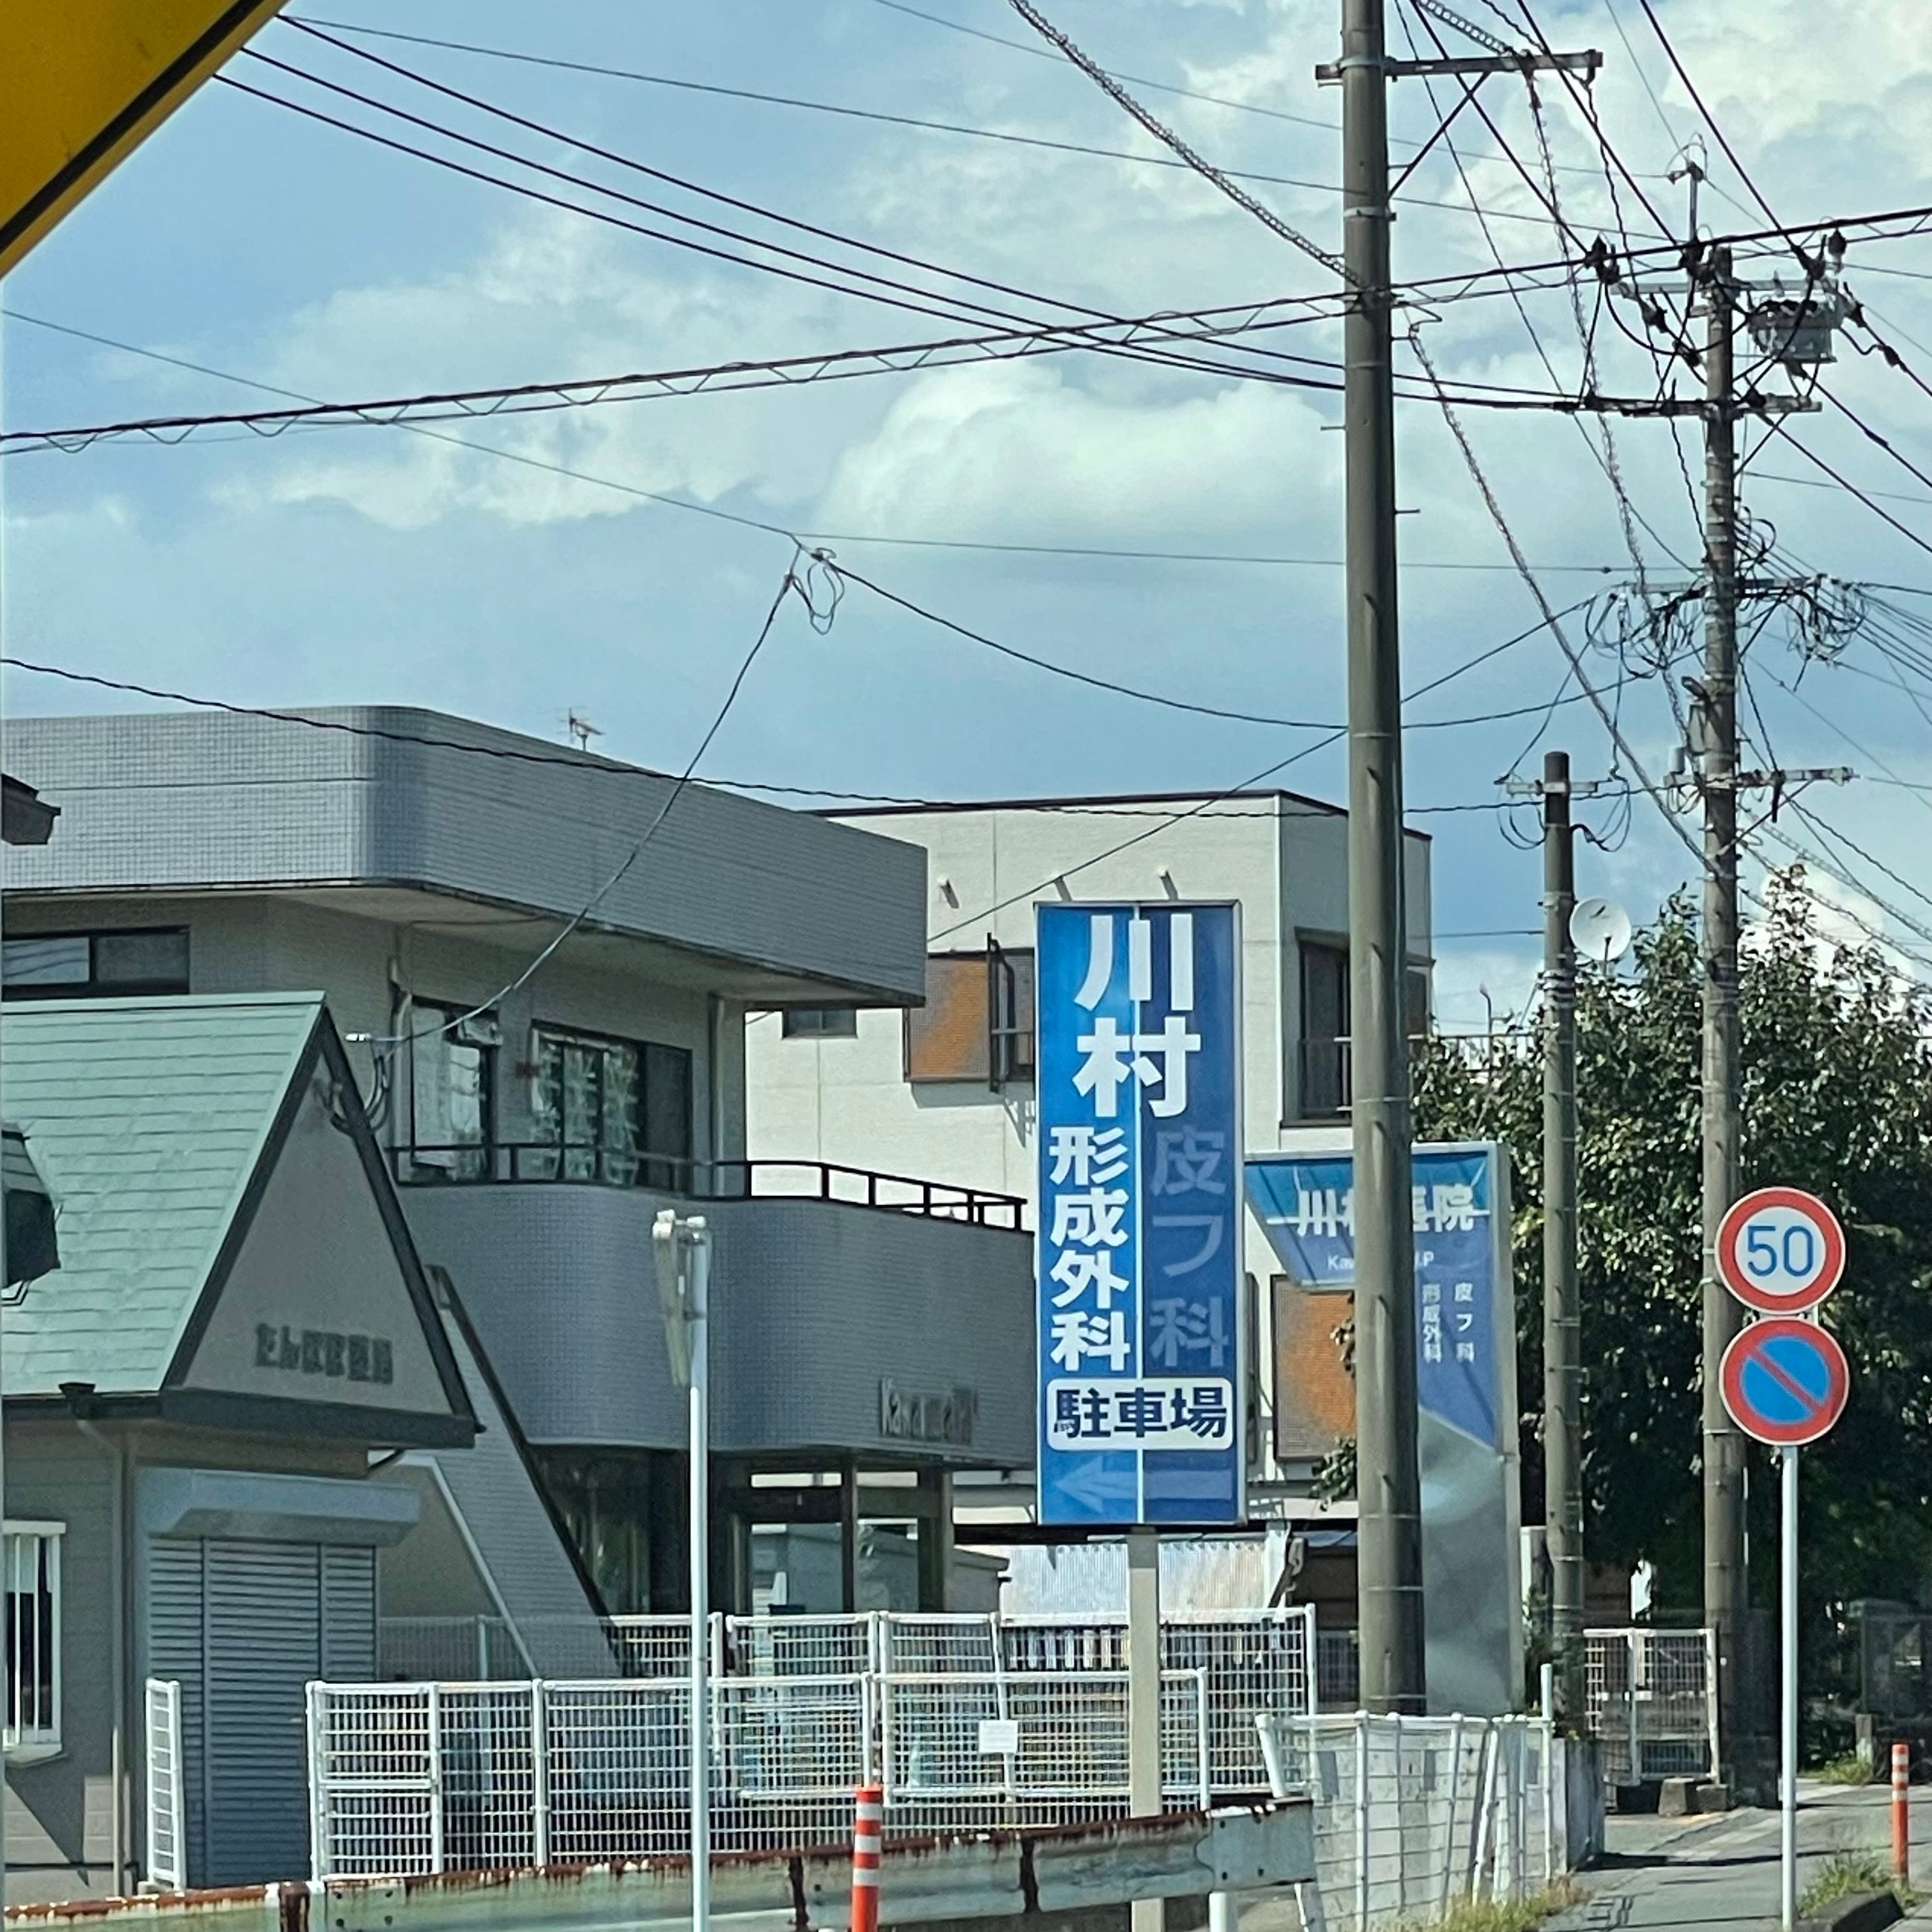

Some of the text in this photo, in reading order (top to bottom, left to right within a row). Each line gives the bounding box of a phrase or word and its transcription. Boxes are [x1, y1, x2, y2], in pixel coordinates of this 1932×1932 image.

[1073, 912, 1201, 1118] 川村
[1049, 1126, 1130, 1371] 形成外科
[1151, 1128, 1229, 1367] 皮フ科
[1298, 1184, 1473, 1237] 川院
[1747, 1225, 1814, 1277] 50
[1054, 1386, 1227, 1440] 駐車場
